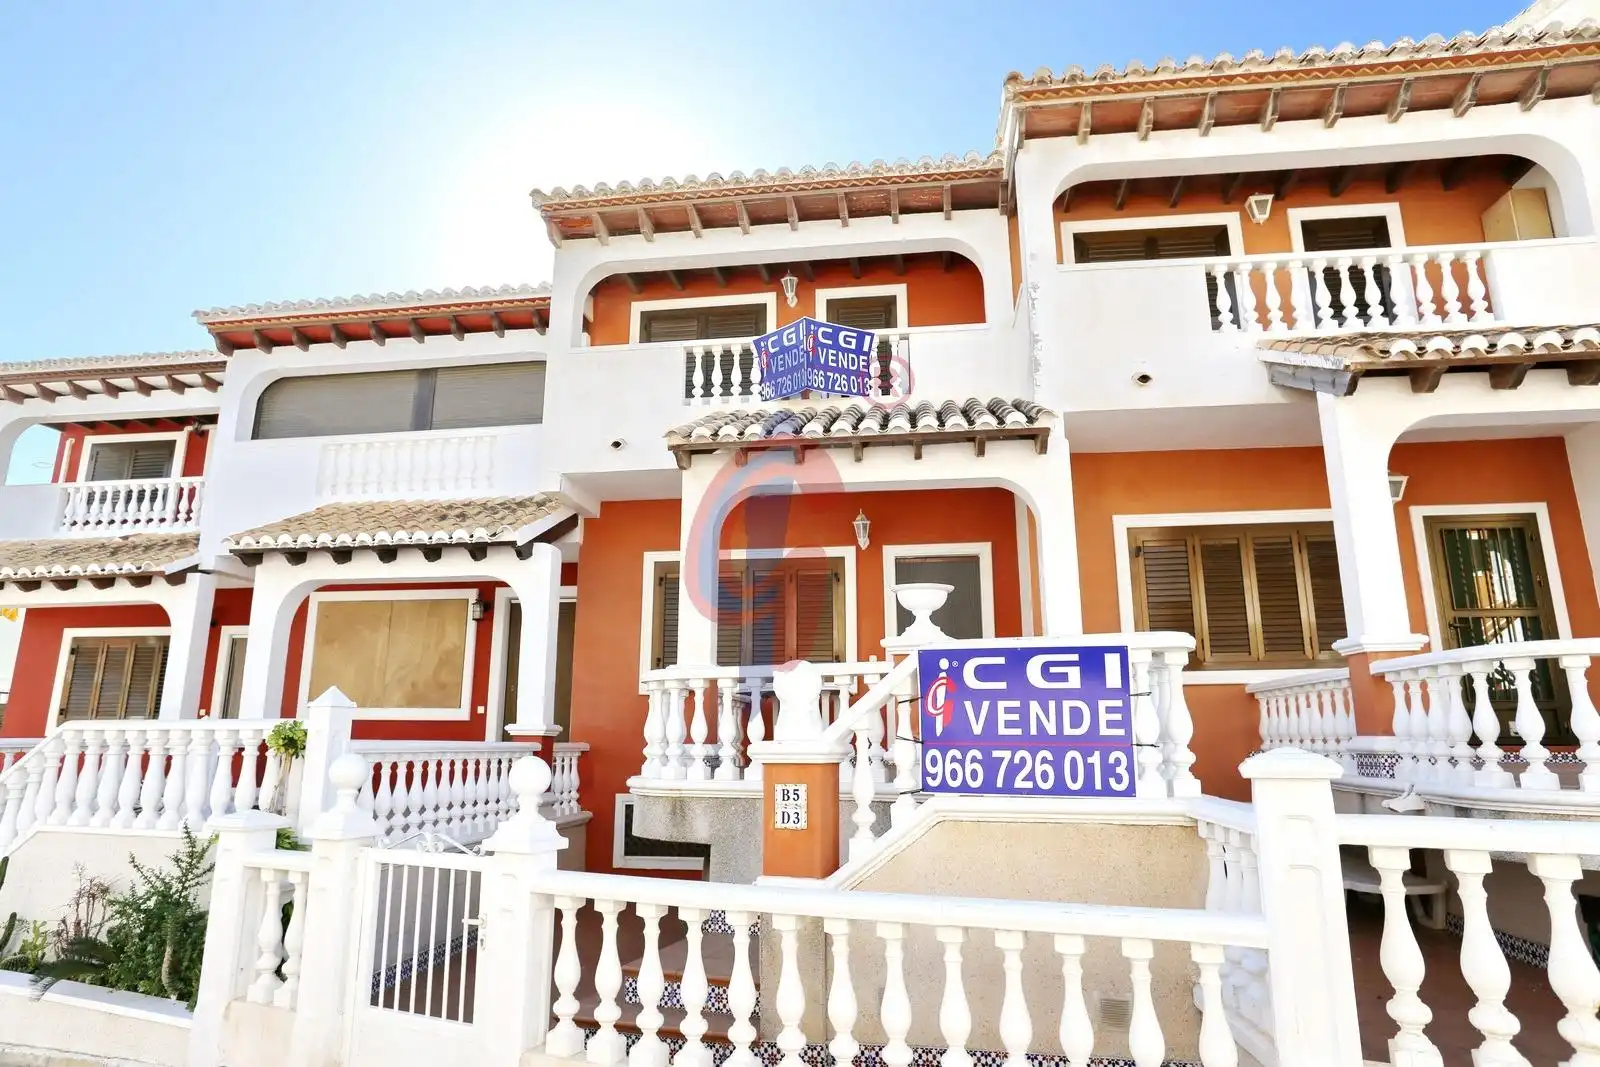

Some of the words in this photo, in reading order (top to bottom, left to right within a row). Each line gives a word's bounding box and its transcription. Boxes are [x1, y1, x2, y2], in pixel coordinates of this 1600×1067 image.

[768, 323, 803, 353] CGI
[818, 327, 871, 352] CGI
[770, 345, 804, 374] VENDE
[818, 347, 868, 372] VENDE
[761, 380, 775, 400] 966
[777, 375, 792, 395] 726
[807, 368, 824, 389] 966
[827, 372, 848, 392] 726
[851, 376, 869, 395] 013
[963, 653, 1122, 690] CGI
[964, 700, 1125, 736] VENDE
[925, 749, 984, 787] 966
[992, 750, 1055, 789] 726
[1064, 750, 1129, 791] 013
